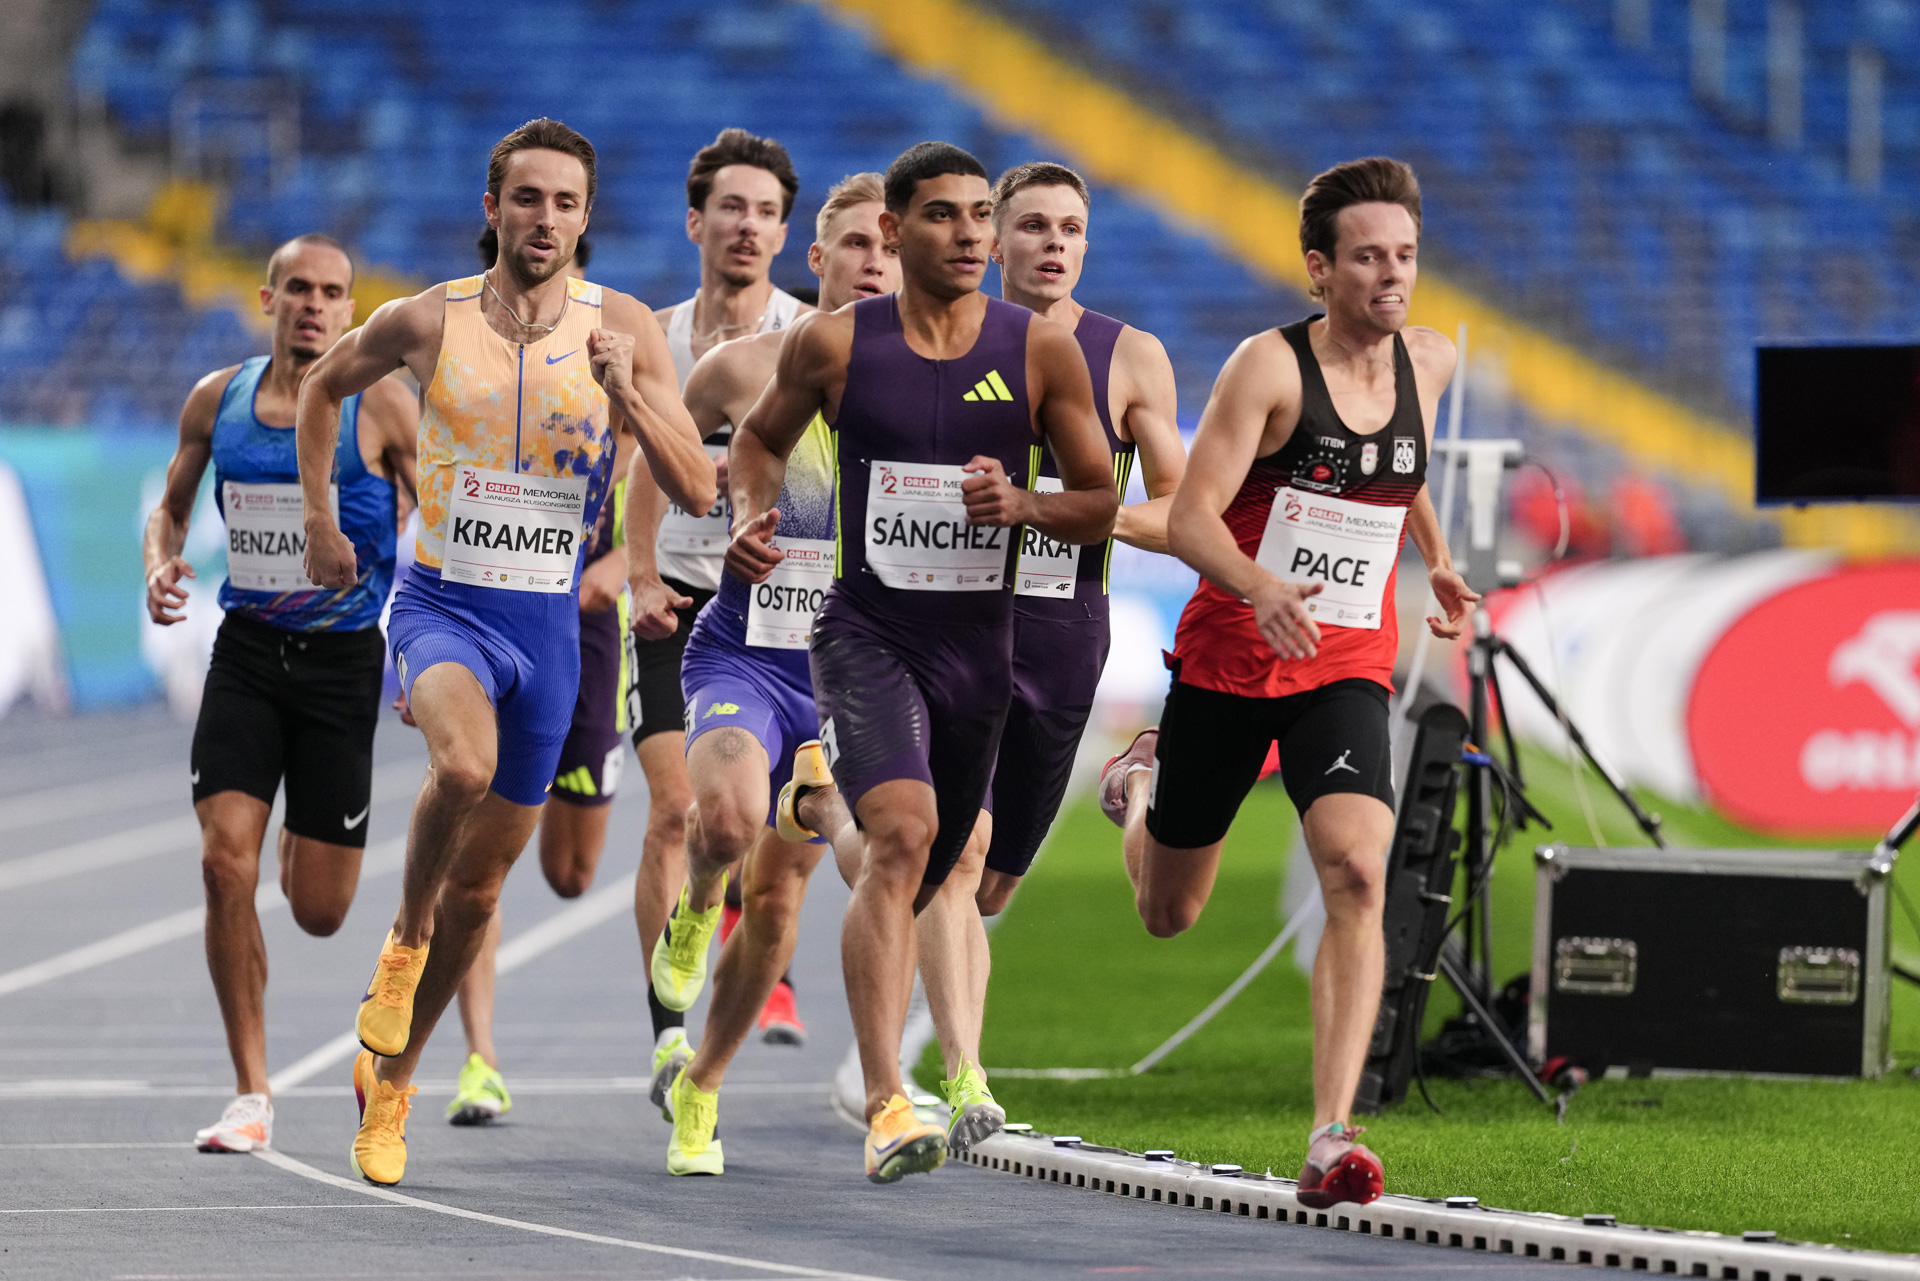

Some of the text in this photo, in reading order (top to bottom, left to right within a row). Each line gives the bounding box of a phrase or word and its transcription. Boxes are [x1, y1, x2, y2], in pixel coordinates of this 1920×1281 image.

[904, 477, 939, 488] ORLEN
[487, 483, 581, 501] ORLEN MEMORIAŁ
[484, 495, 581, 509] JANUSZA KUSOCIŃSKIEGO
[1309, 509, 1342, 522] ORLEN
[452, 516, 574, 556] KRAMER
[872, 512, 1003, 550] SÁNCHEZ
[787, 550, 819, 560] ORLEN
[1290, 547, 1370, 587] PACE
